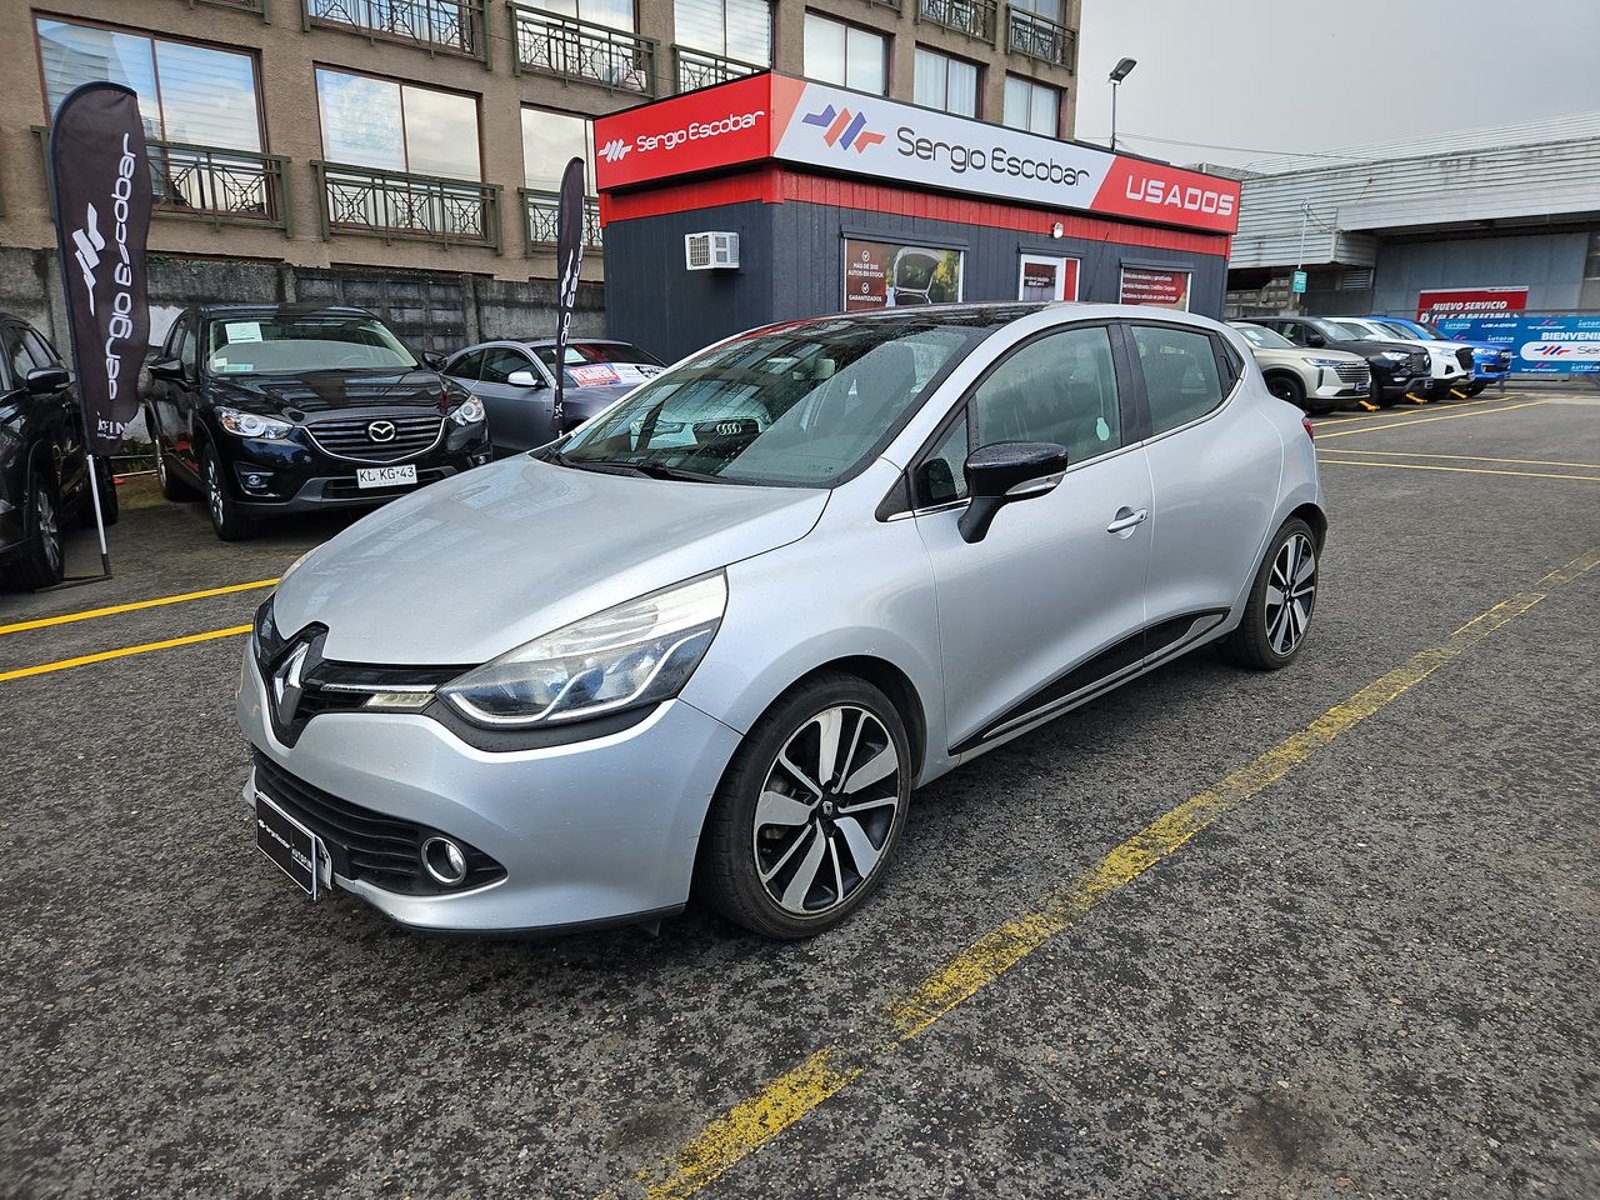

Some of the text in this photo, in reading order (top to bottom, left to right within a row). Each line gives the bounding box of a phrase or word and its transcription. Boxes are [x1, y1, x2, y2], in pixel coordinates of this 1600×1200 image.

[636, 111, 765, 152] Sergio Escobar
[896, 126, 1090, 186] Sergio Escobar
[1125, 175, 1235, 216] USADOS
[1432, 301, 1508, 311] NUEVO SERVICIO
[1541, 331, 1600, 340] BIENVENI
